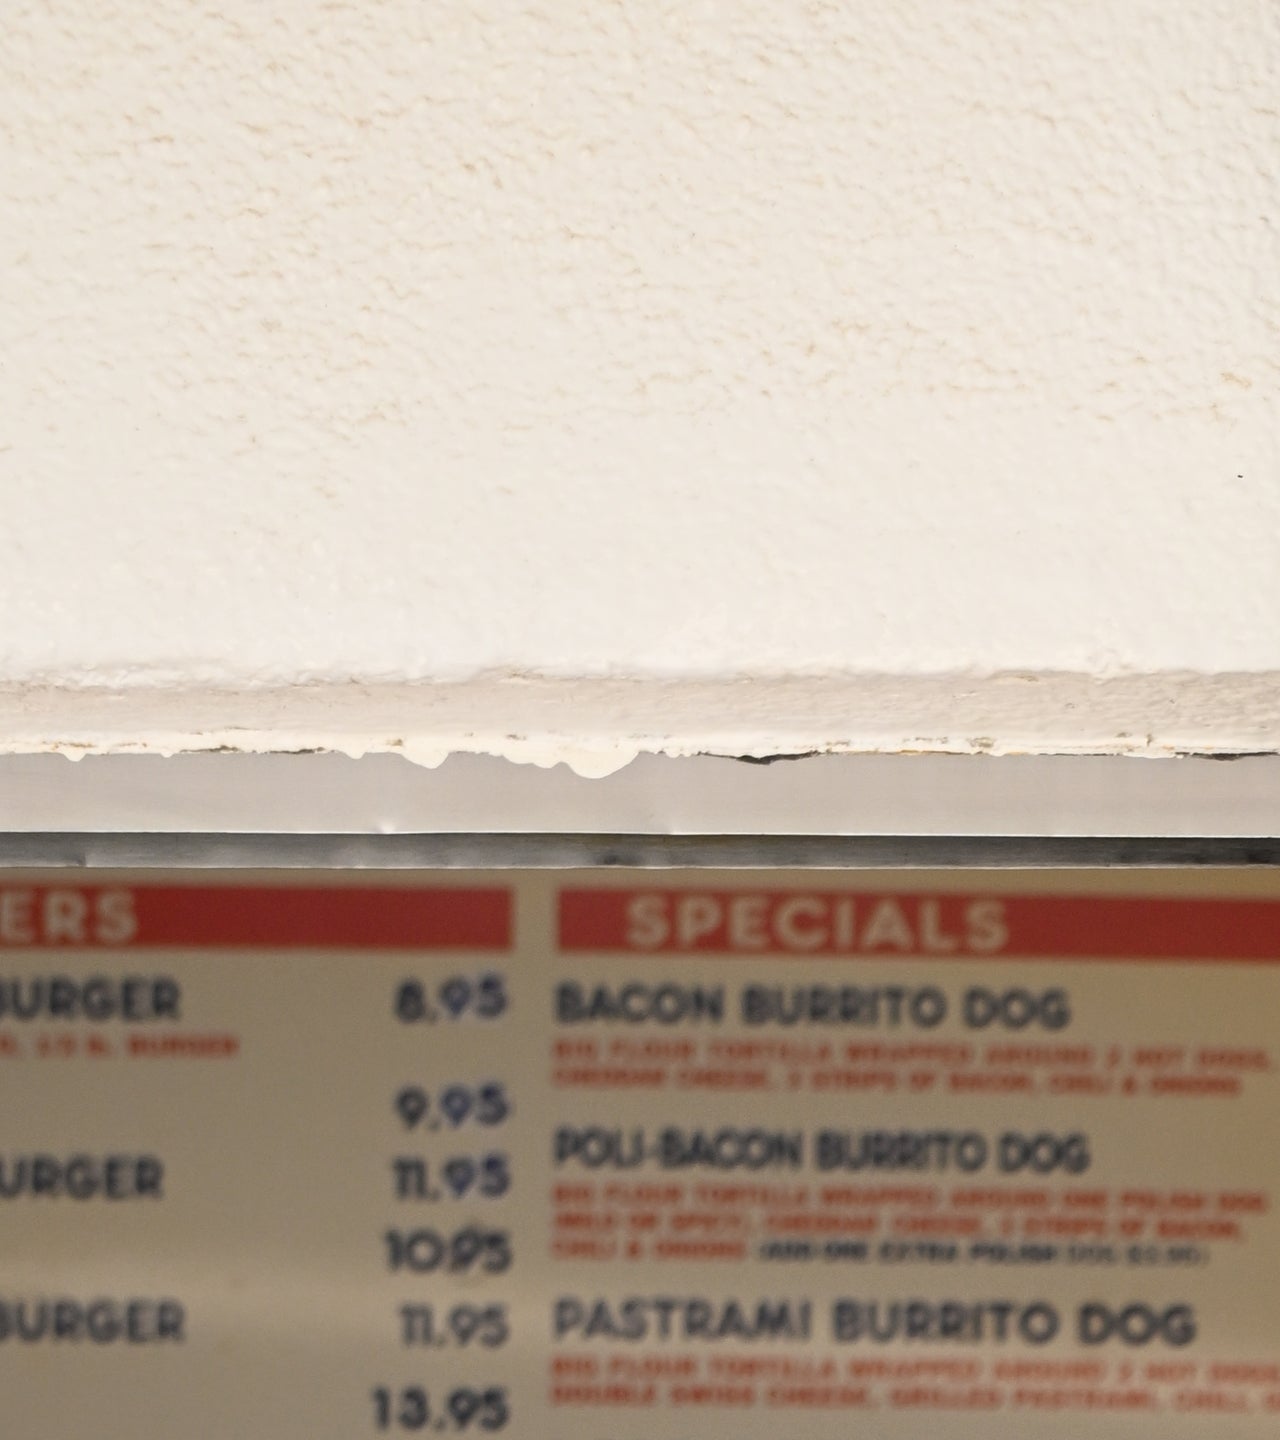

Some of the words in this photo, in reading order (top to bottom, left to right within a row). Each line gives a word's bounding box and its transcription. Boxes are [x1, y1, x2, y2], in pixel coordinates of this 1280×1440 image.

[627, 896, 1007, 951] SPECIALS
[394, 974, 508, 1024] 8.95
[553, 981, 725, 1025] BACON
[740, 984, 947, 1029] BURRITO
[962, 986, 1071, 1032] DOG
[394, 1082, 510, 1130] 9.95
[814, 1129, 988, 1173] BURRITO
[997, 1131, 1091, 1175] DOG
[392, 1153, 511, 1201] 11.95
[400, 1305, 509, 1348] 11.95
[555, 1298, 811, 1340] PASTRAMI
[831, 1298, 1060, 1345] BURRITO
[1076, 1300, 1198, 1347] DOG
[373, 1387, 509, 1431] 13.95
